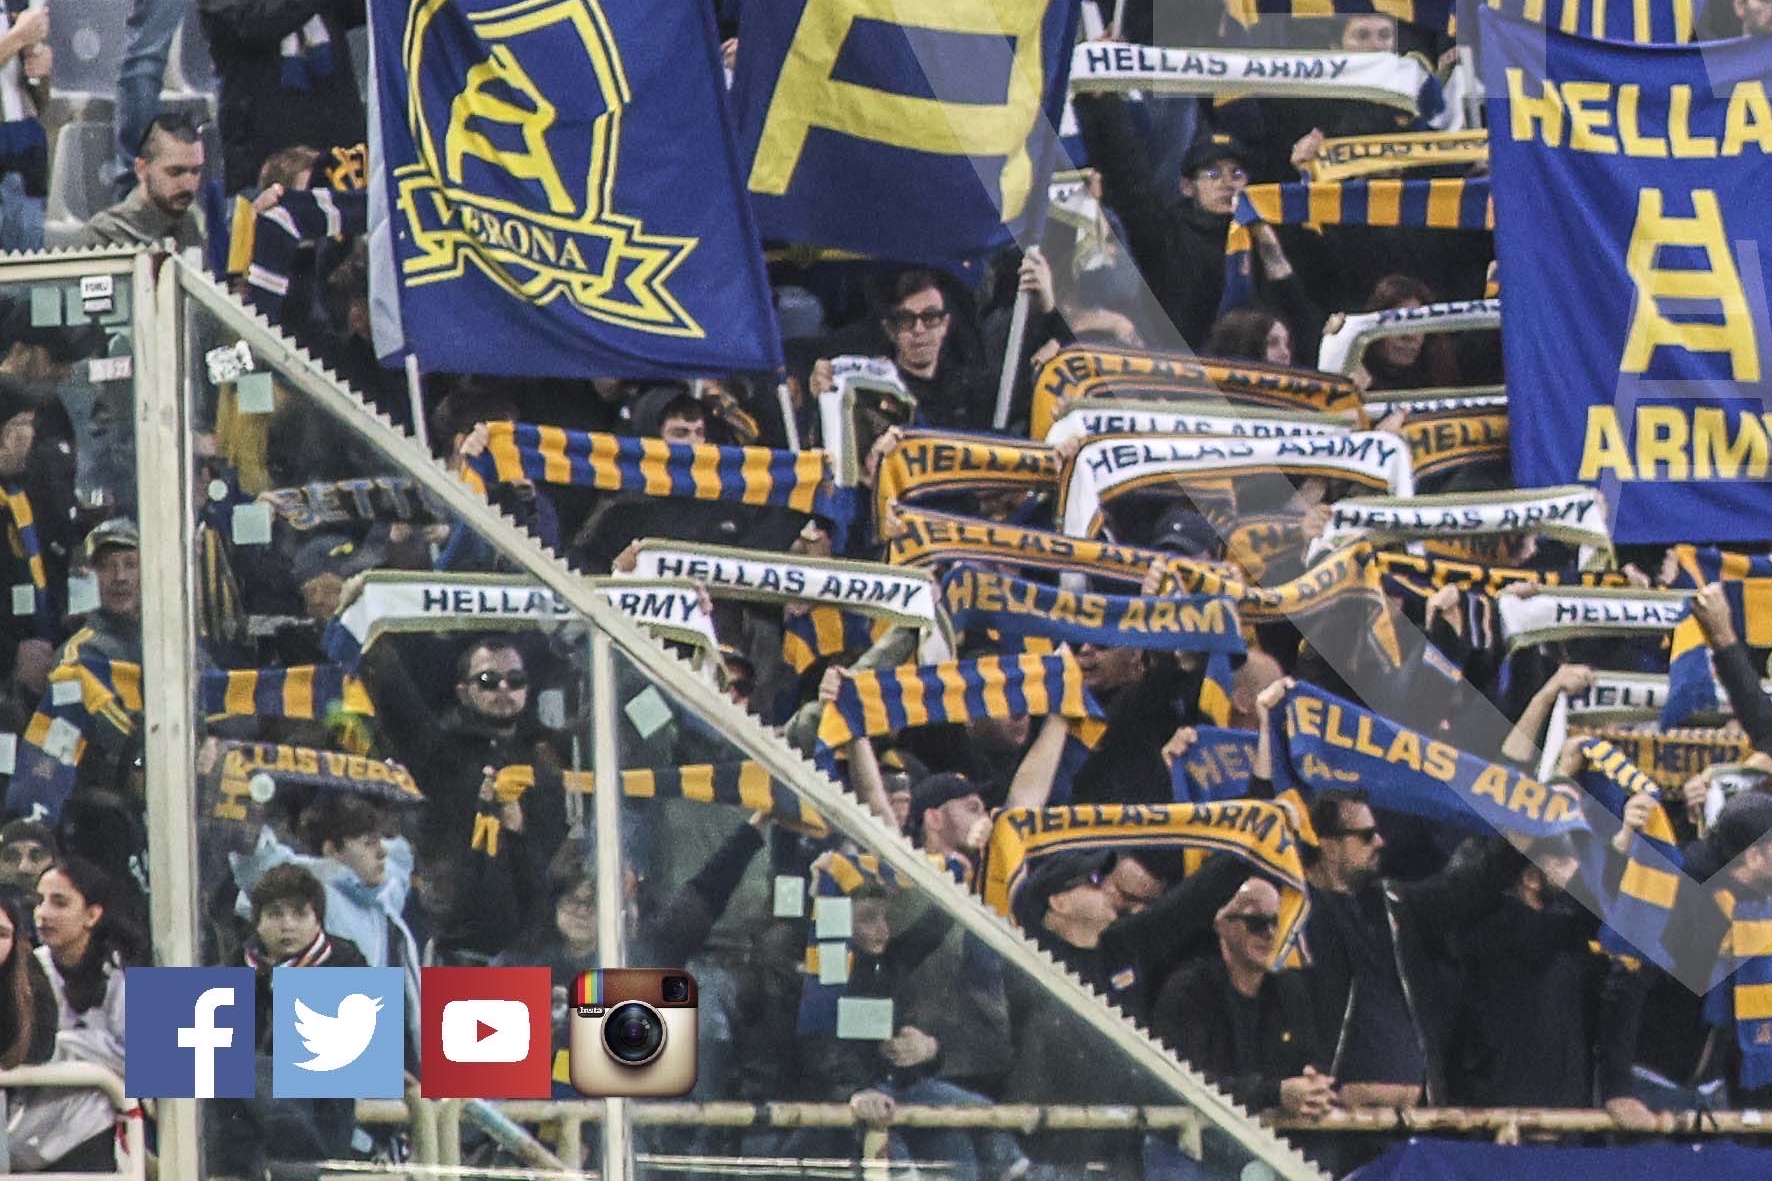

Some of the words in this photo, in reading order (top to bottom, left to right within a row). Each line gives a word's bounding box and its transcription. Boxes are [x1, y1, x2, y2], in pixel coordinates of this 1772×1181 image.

[1086, 49, 1229, 77] HELLAS
[1242, 57, 1350, 80] ARMY
[1044, 355, 1208, 398] HELLAS
[1226, 369, 1354, 406] ARMY
[1085, 440, 1255, 481] HELLAS
[1275, 435, 1398, 468] ARMY
[1332, 506, 1484, 530] HELLAS
[1499, 498, 1595, 528] ARMY
[892, 519, 1076, 557] HELLAS
[421, 588, 570, 616] HELLAS
[655, 555, 807, 595] HELLAS
[819, 574, 923, 609] ARMY
[946, 569, 1108, 629] HELLAS
[1006, 803, 1172, 841] HELLAS
[1187, 803, 1296, 855] ARMY
